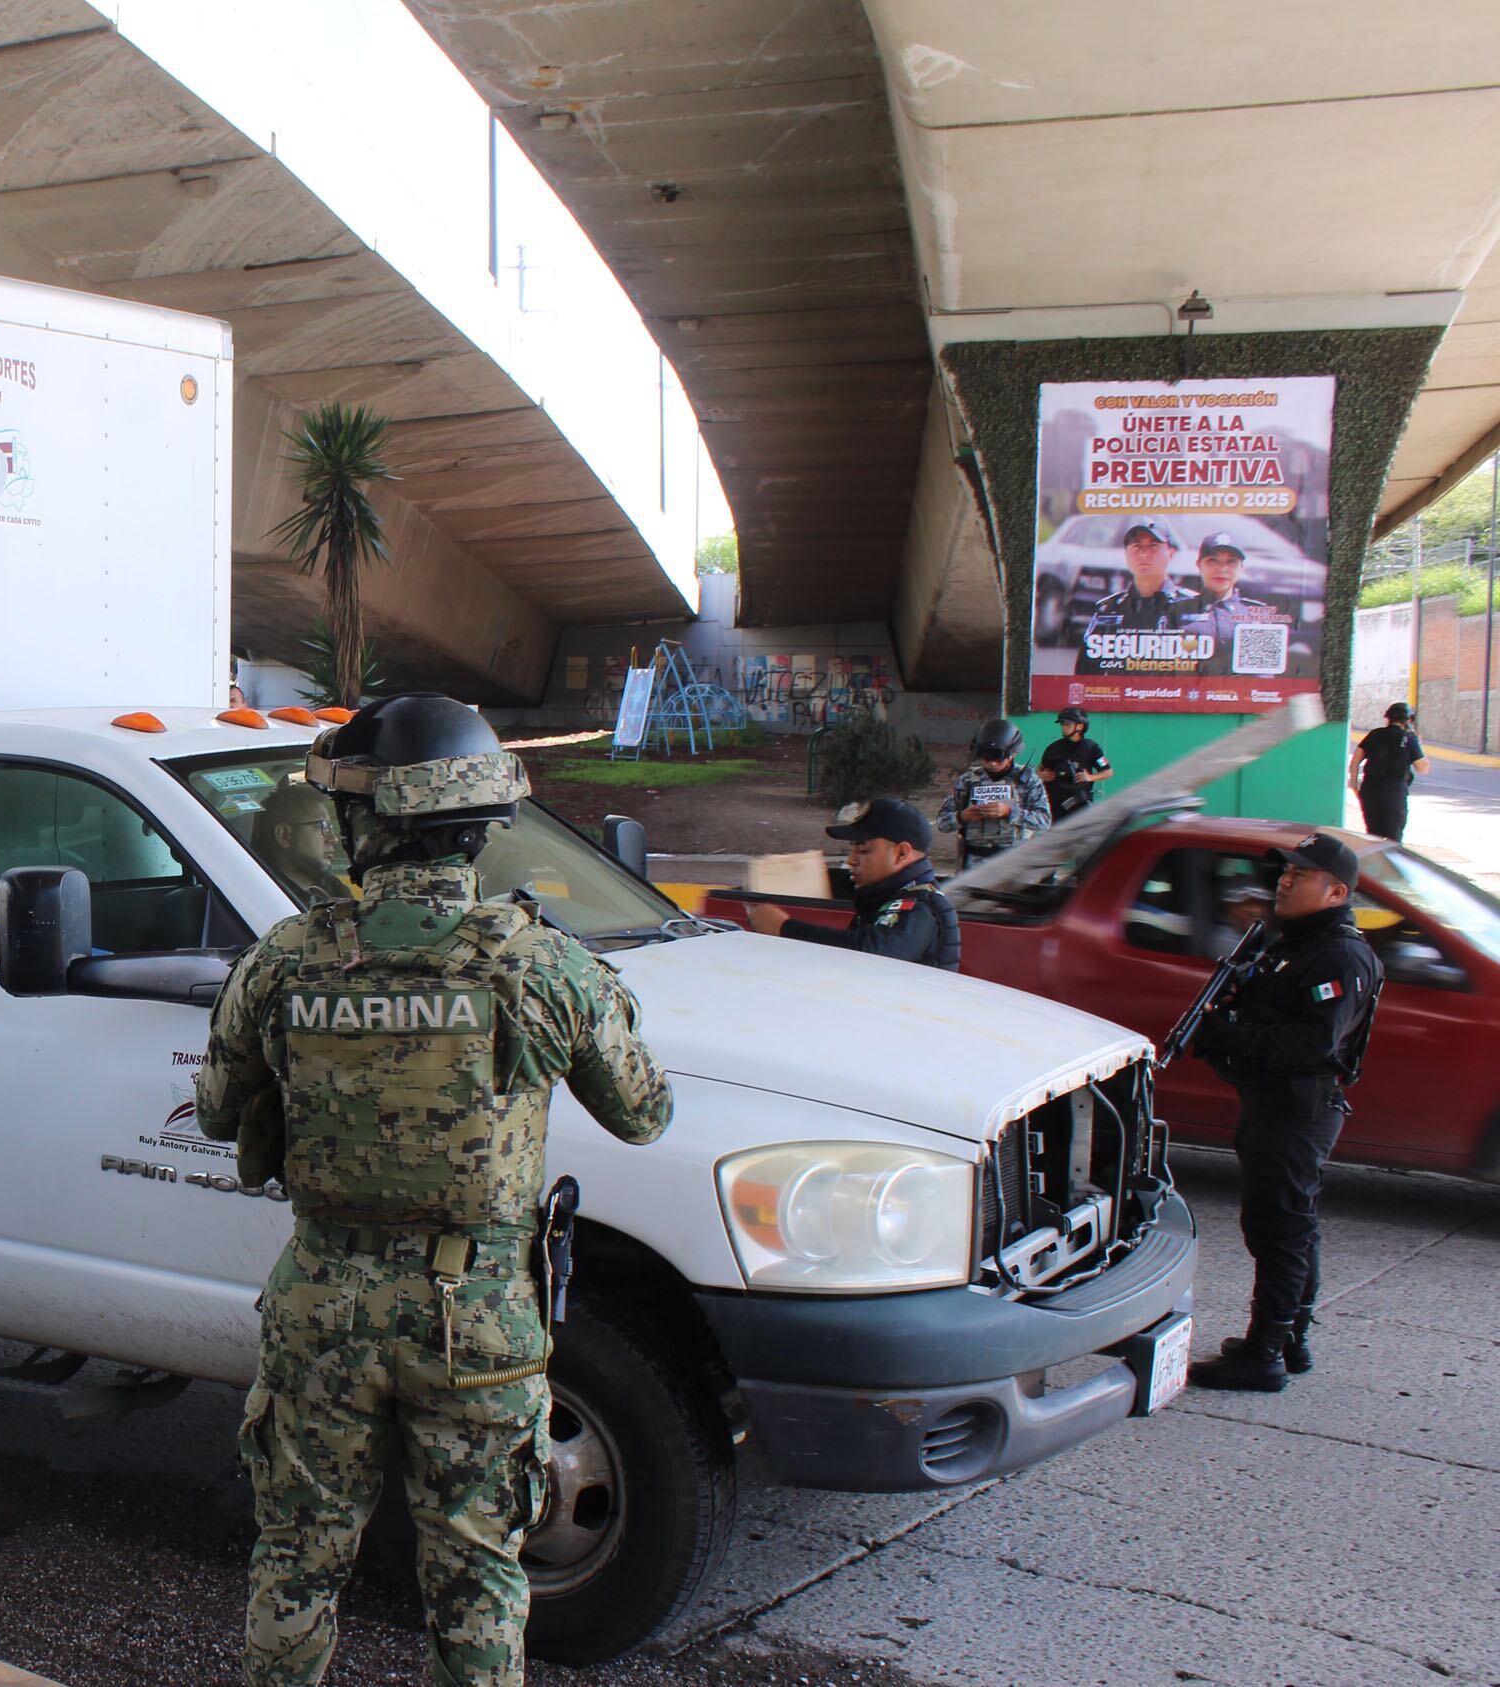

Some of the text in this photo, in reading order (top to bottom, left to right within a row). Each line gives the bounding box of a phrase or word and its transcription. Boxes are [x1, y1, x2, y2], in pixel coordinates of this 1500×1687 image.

[1094, 391, 1278, 410] CON VALOR Y VOCACIÓN
[1122, 413, 1244, 433] ÚNETE A LA
[1187, 435, 1279, 453] ESTATAL
[1090, 459, 1282, 484] PREVENTIVA
[1084, 492, 1290, 509] RECLUTAMIENTO 2025
[7, 516, 21, 525] CADA
[1100, 657, 1198, 672] con bienestar
[1124, 687, 1181, 699] Seguridad
[976, 786, 1008, 794] GUARDIA
[291, 995, 478, 1028] MARINA
[139, 1135, 157, 1147] Ruly
[159, 1139, 189, 1153] Antony
[191, 1144, 221, 1157] Galvan
[223, 1150, 239, 1160] Jua
[100, 1154, 177, 1183] RAM
